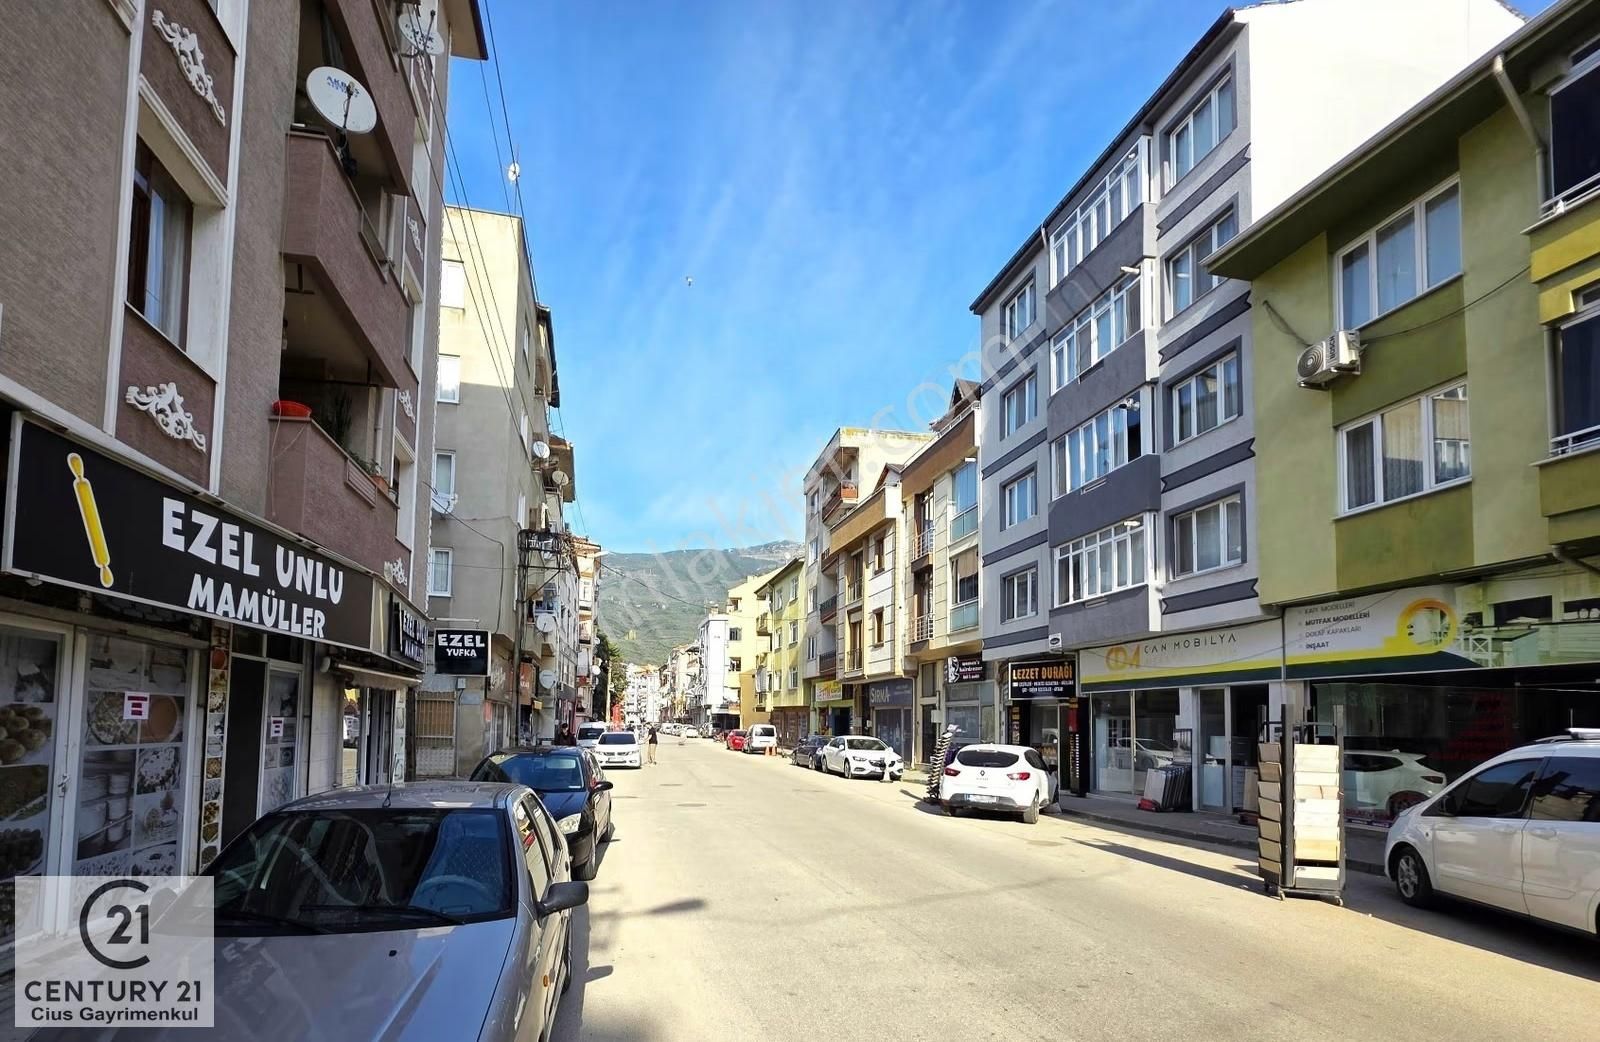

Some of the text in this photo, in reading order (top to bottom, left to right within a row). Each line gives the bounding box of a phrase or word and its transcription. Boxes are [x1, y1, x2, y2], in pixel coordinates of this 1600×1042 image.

[162, 497, 344, 605] EZEL UNLU
[187, 573, 326, 639] MAMÜLLER
[437, 633, 486, 648] EZEL
[446, 648, 477, 658] YUFKA
[1012, 667, 1040, 680] LEZZET
